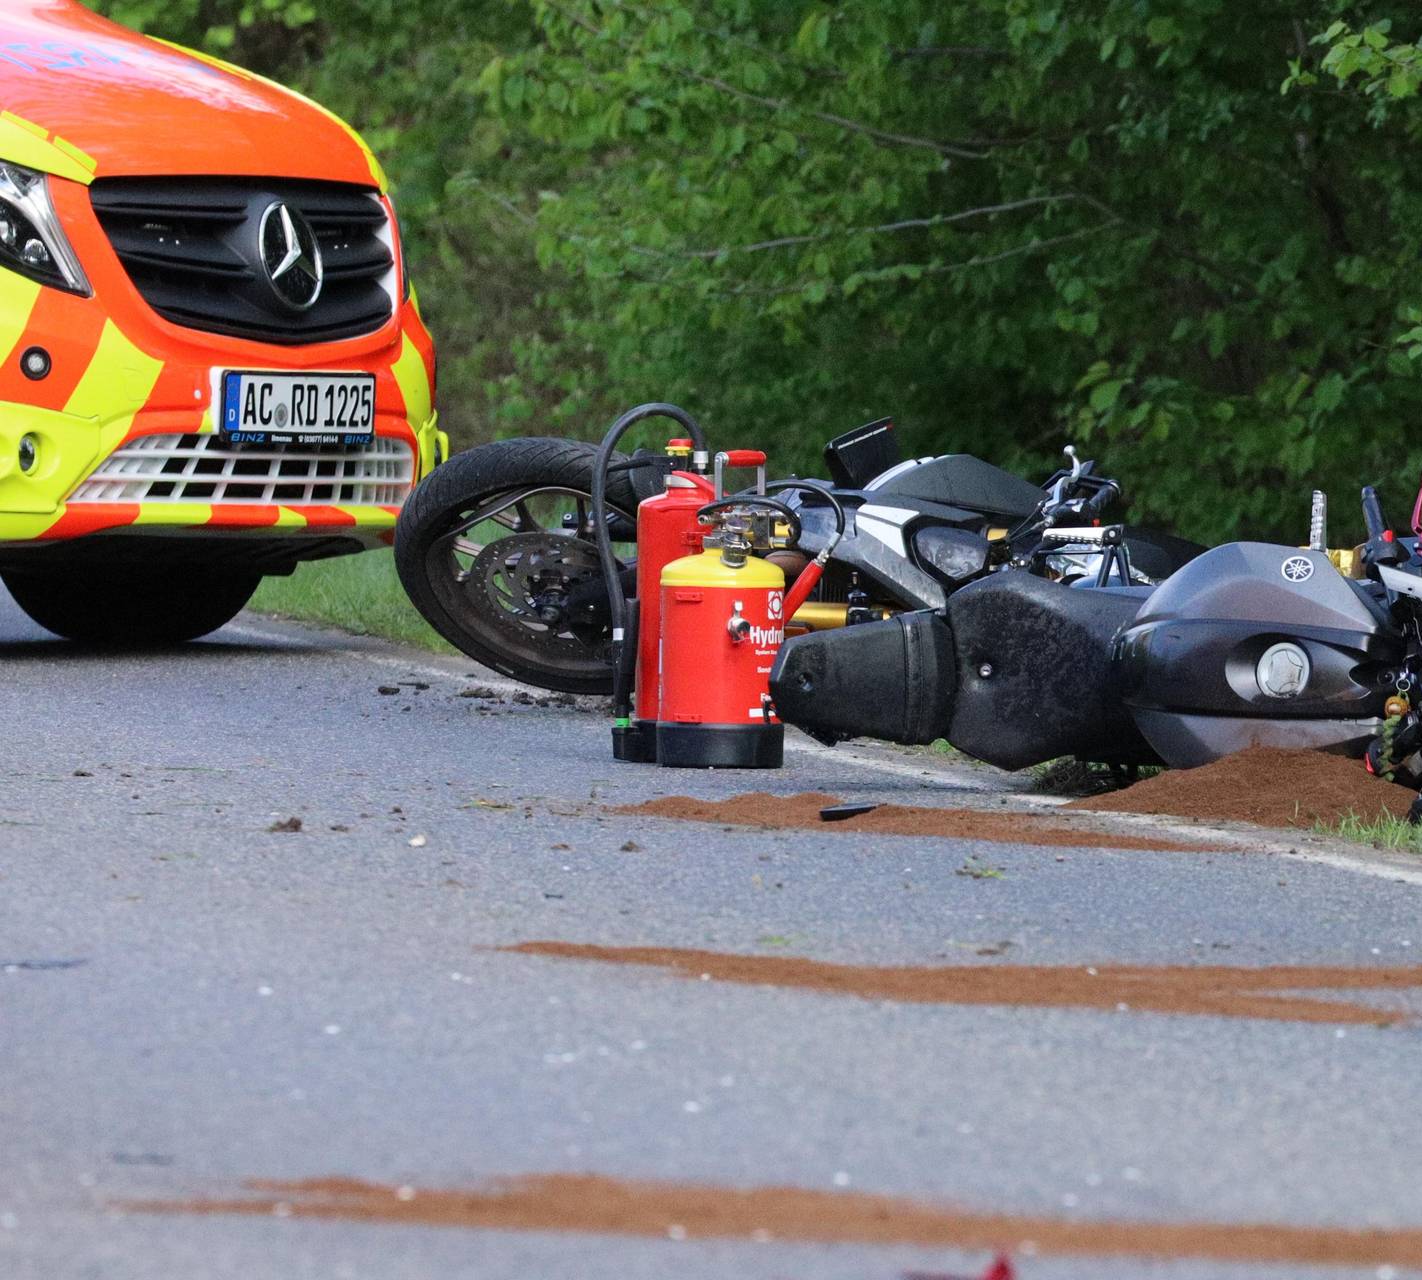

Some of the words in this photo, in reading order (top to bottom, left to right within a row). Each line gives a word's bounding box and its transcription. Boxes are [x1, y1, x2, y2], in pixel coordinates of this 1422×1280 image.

[243, 382, 273, 425] AC
[291, 383, 319, 427] RD
[324, 384, 371, 428] 1225
[229, 409, 235, 422] D
[231, 433, 265, 443] BINZ
[344, 434, 370, 444] BINZ
